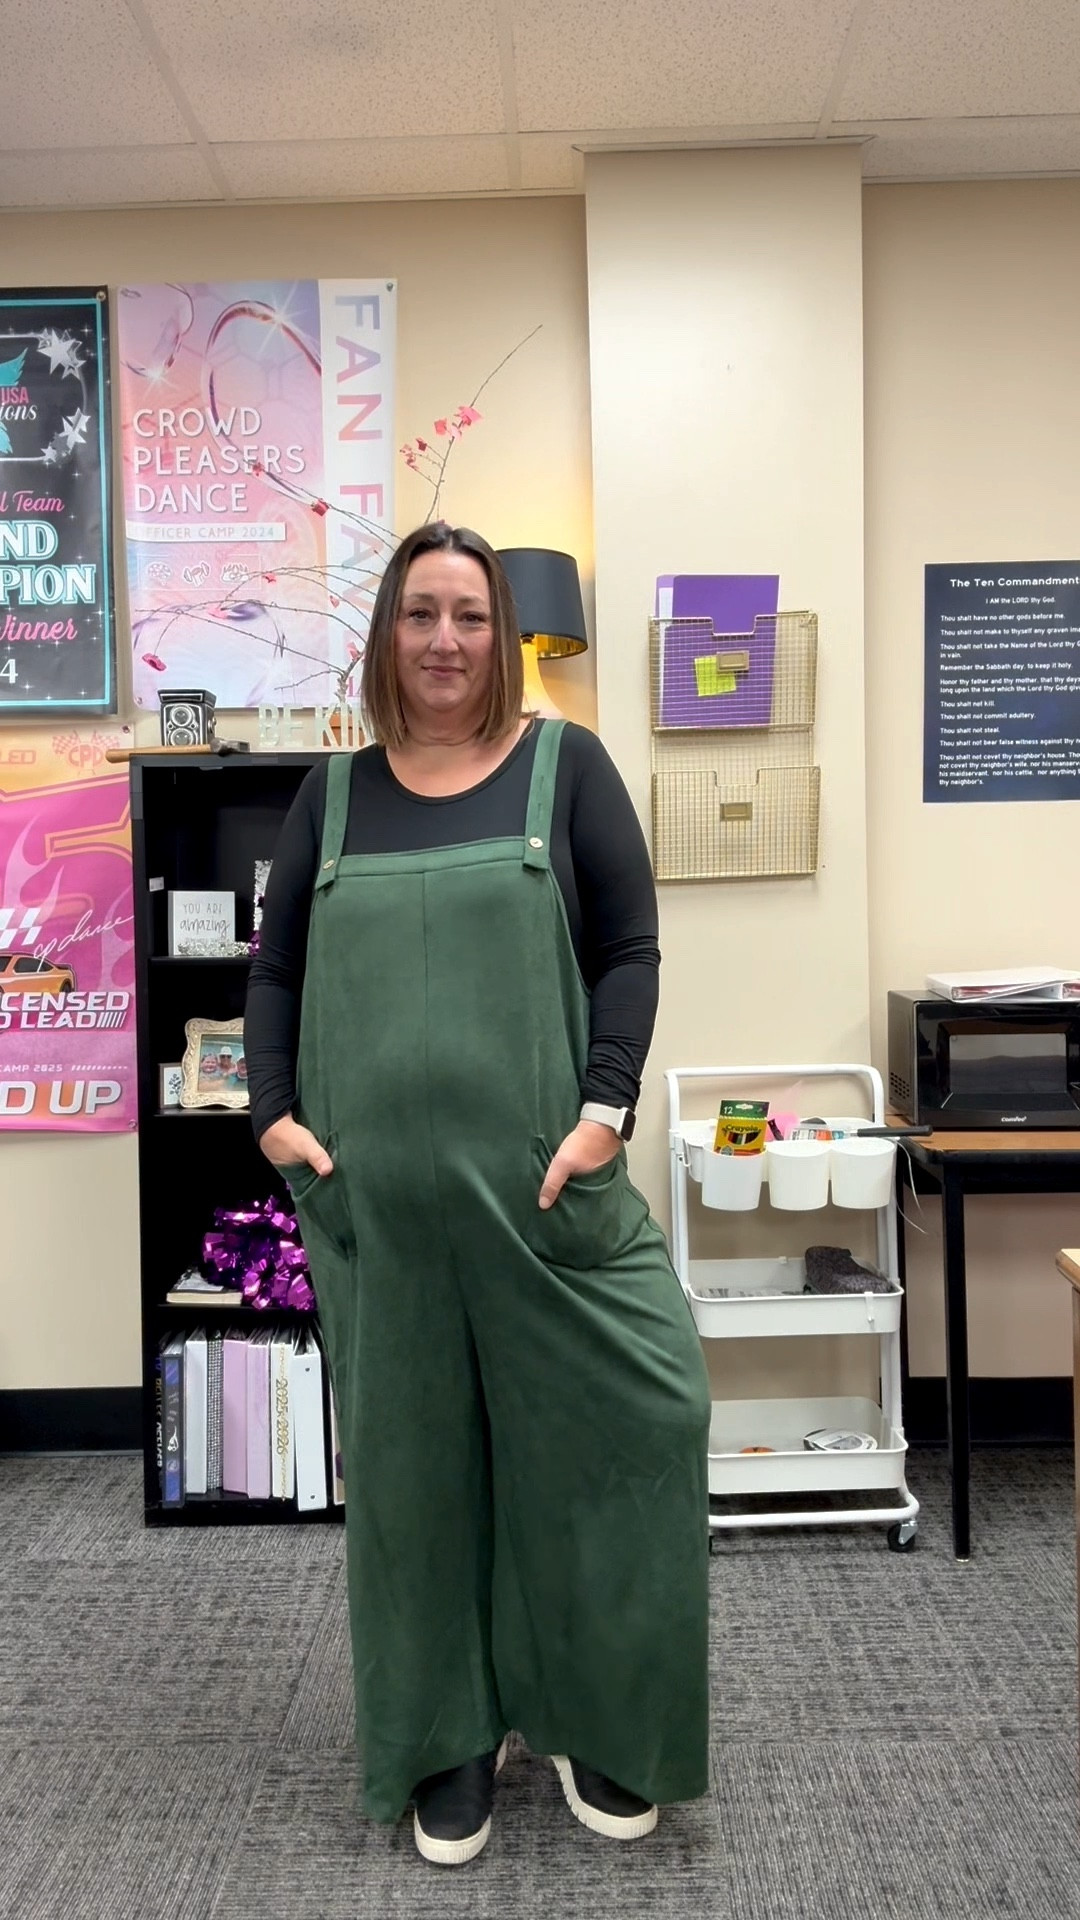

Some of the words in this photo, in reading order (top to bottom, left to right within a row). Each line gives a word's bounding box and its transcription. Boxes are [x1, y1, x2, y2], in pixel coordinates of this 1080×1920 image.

[335, 294, 383, 442] FAN
[132, 407, 261, 438] CROWD
[133, 445, 306, 476] PLEASERS
[12, 490, 65, 512] Team
[133, 483, 249, 513] DANCE
[198, 527, 236, 539] CAMP
[242, 527, 274, 539] 2024
[950, 579, 970, 587] The
[974, 579, 994, 587] Ten
[1011, 628, 1032, 636] thyself
[1047, 627, 1068, 635] graven
[1035, 662, 1050, 670] keep
[258, 703, 304, 748] BE
[1040, 738, 1062, 746] against
[1002, 753, 1012, 761] thy
[1014, 752, 1046, 760] neighbor's
[1050, 768, 1076, 776] anything
[183, 903, 201, 914] YOU
[180, 917, 231, 938] amazing
[0, 991, 130, 1011] CENSED
[20, 1012, 98, 1029] LEAD
[33, 1064, 63, 1073] 2025
[49, 1080, 122, 1115] UP
[723, 1106, 733, 1115] 12
[725, 1123, 760, 1133] Crayola
